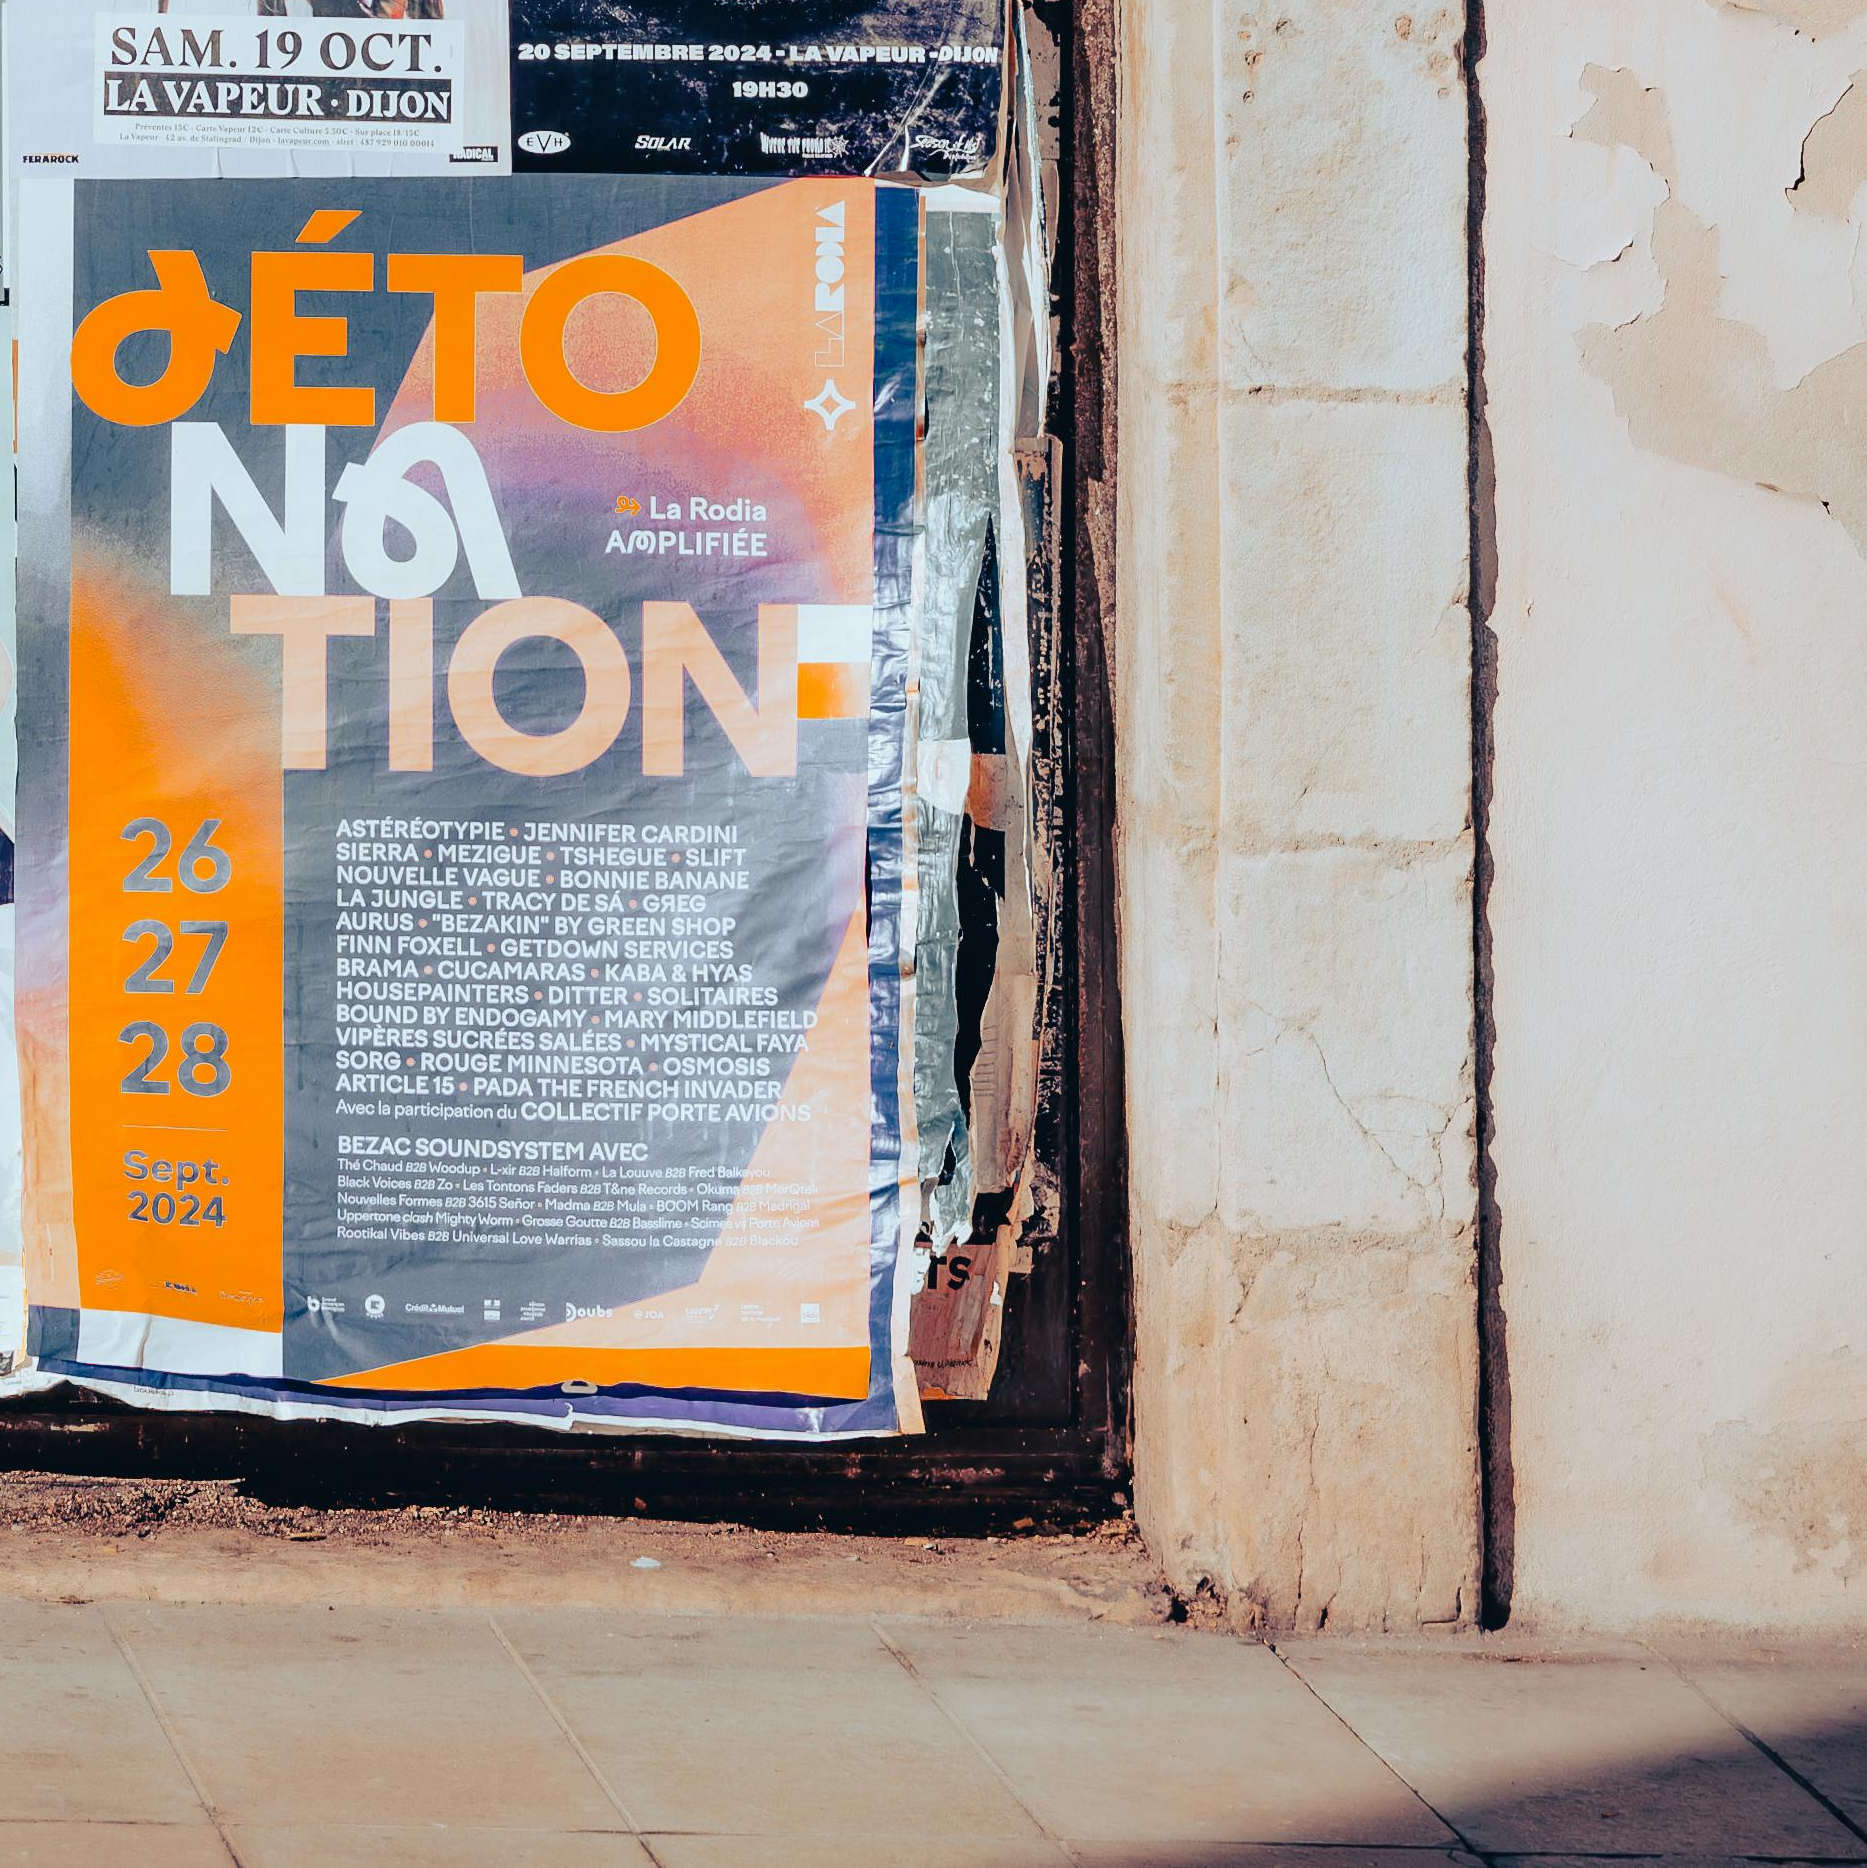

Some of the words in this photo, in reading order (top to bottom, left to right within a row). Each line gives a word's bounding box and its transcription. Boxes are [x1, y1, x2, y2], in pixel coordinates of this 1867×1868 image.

[111, 26, 237, 69] SAM.
[254, 28, 303, 69] 19
[319, 31, 443, 74] OCT.
[518, 43, 550, 61] 20
[554, 44, 704, 62] SEPTEMBRE
[709, 44, 772, 61] 2024
[790, 46, 820, 62] LA
[826, 46, 925, 64] VAPEUR
[105, 77, 157, 114] LA
[162, 78, 325, 117] VAPEUR
[346, 88, 452, 122] DIJON
[733, 81, 808, 98] 19H30
[649, 496, 682, 521] La
[689, 495, 768, 522] Rodia
[230, 595, 798, 777] TION
[336, 819, 506, 841] ASTÉRÉOTYPIE
[523, 823, 637, 843] JENNIFER
[641, 824, 738, 844] CARDINI
[119, 816, 233, 895] 26
[336, 843, 420, 862] SIERRA
[438, 845, 542, 866] MEZIGUE
[560, 846, 667, 867] TSHEGUE
[685, 848, 746, 867] SLIFT
[121, 918, 230, 995] 27
[117, 1020, 233, 1098] 28
[337, 1136, 412, 1157] BEZAC
[415, 1138, 585, 1160] SOUNDSYSTEM
[589, 1141, 649, 1161] AVEC
[337, 1158, 360, 1172] Thé
[362, 1159, 403, 1173] Chaud
[406, 1161, 427, 1174] B2B
[429, 1162, 481, 1177] Woodup
[122, 1148, 231, 1191] Sept.
[127, 1190, 228, 1228] 2024
